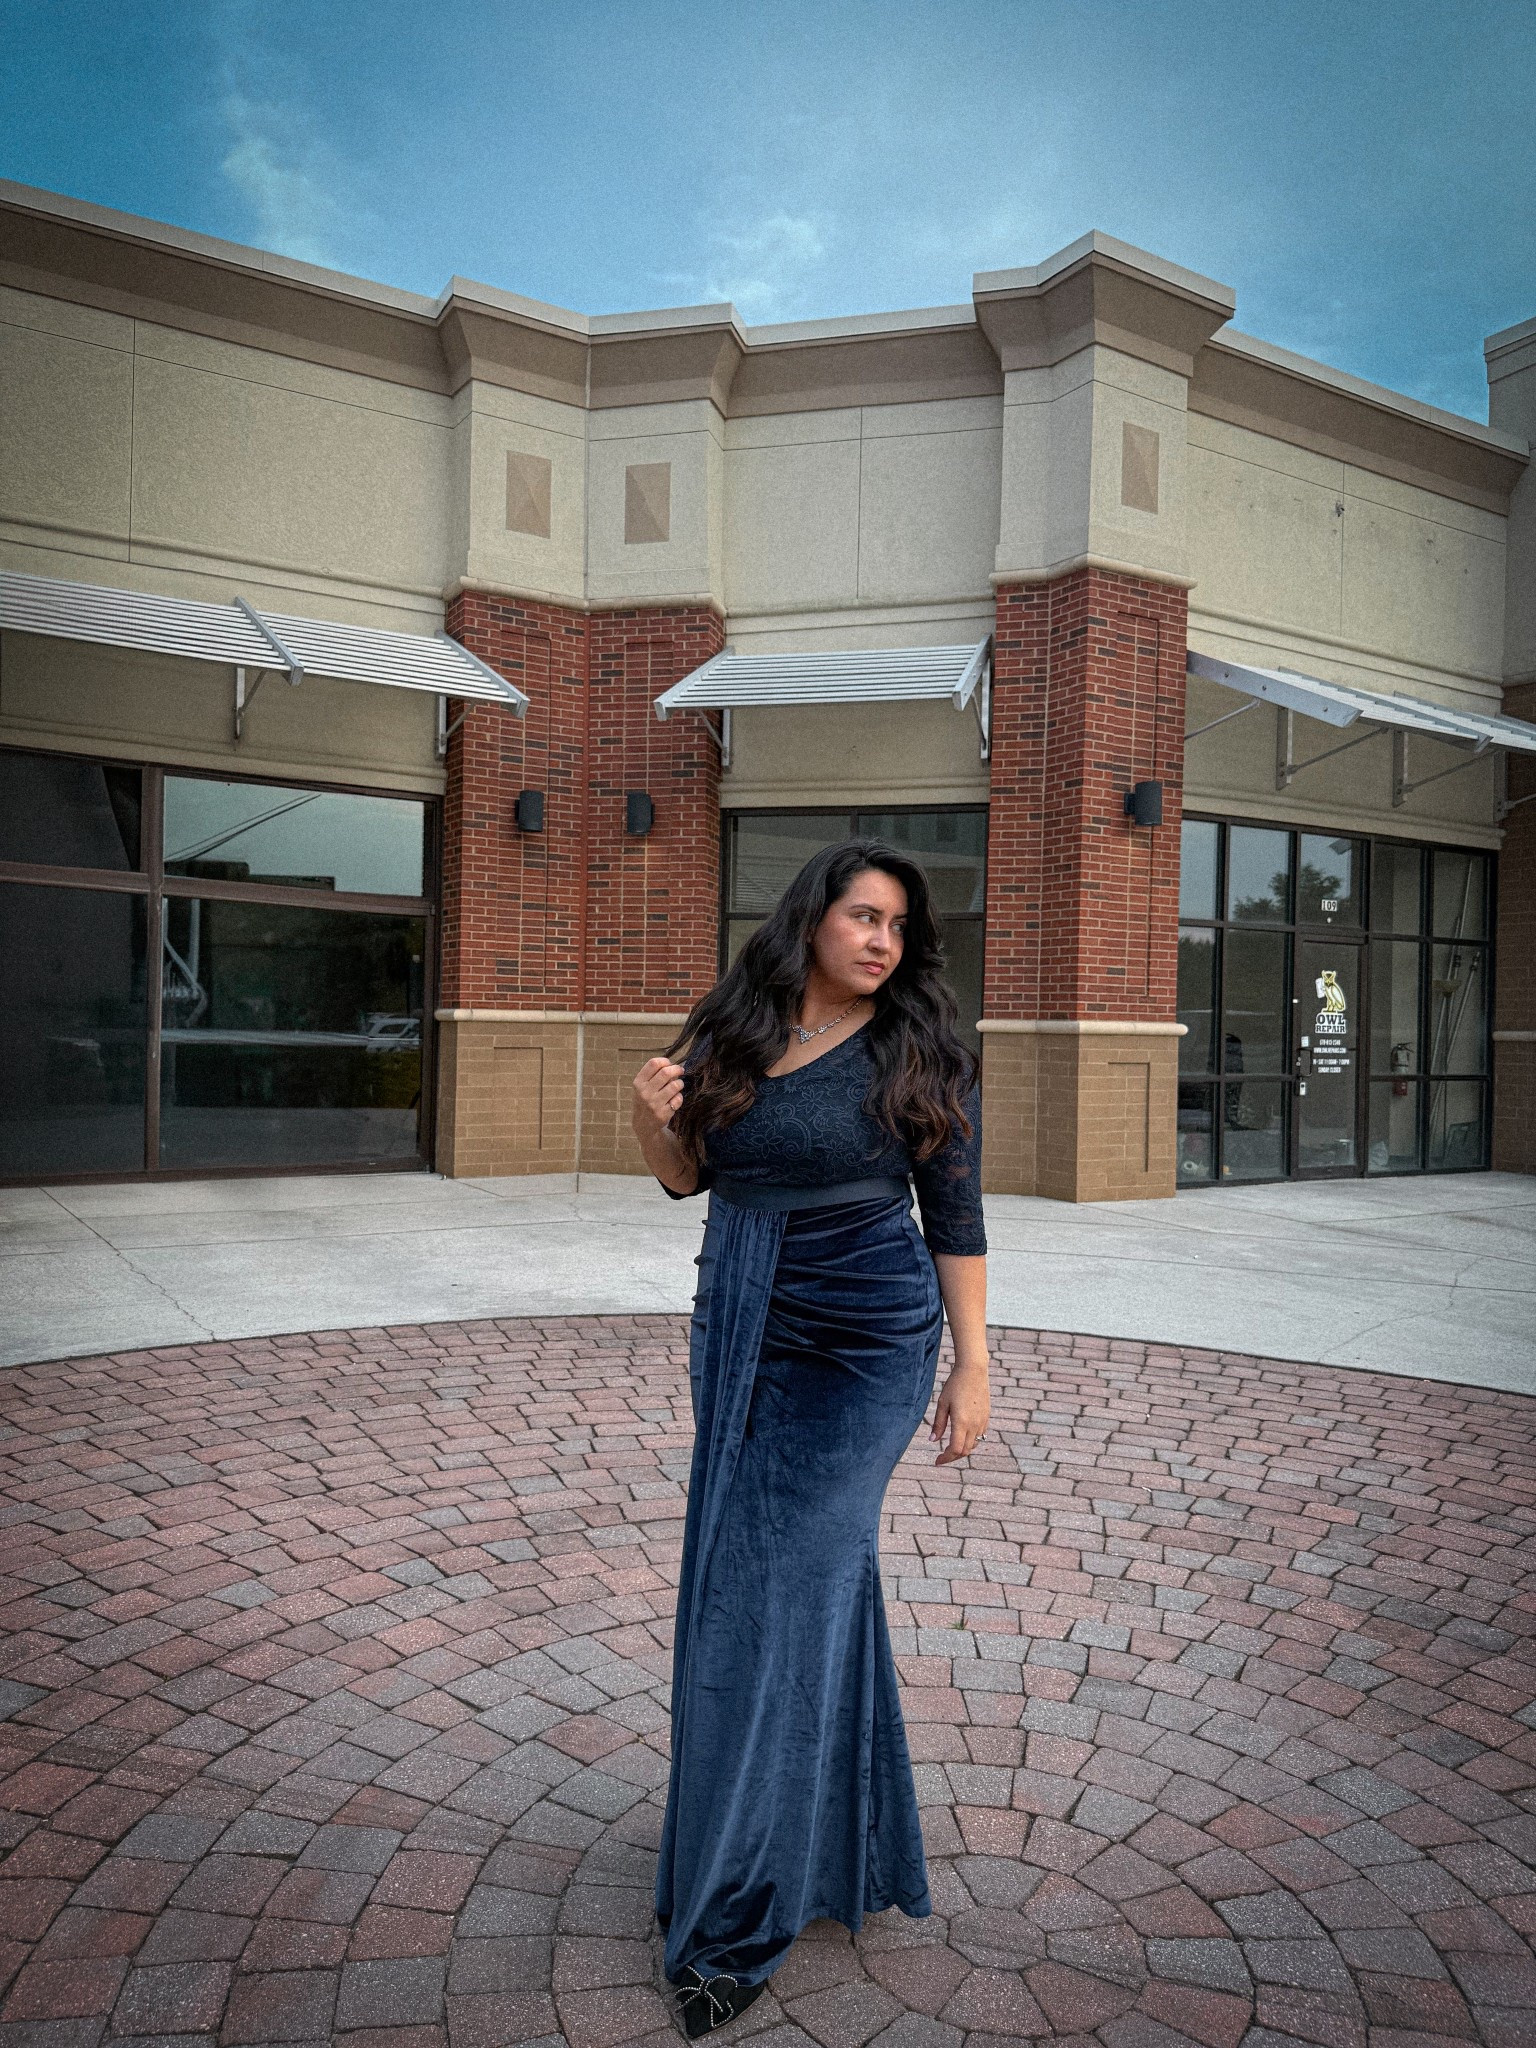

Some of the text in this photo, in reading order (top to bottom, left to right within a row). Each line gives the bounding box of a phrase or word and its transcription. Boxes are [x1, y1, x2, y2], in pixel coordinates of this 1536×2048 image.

[1322, 900, 1337, 910] 109
[1316, 1014, 1345, 1025] OWL
[1316, 1025, 1346, 1033] REPAIR
